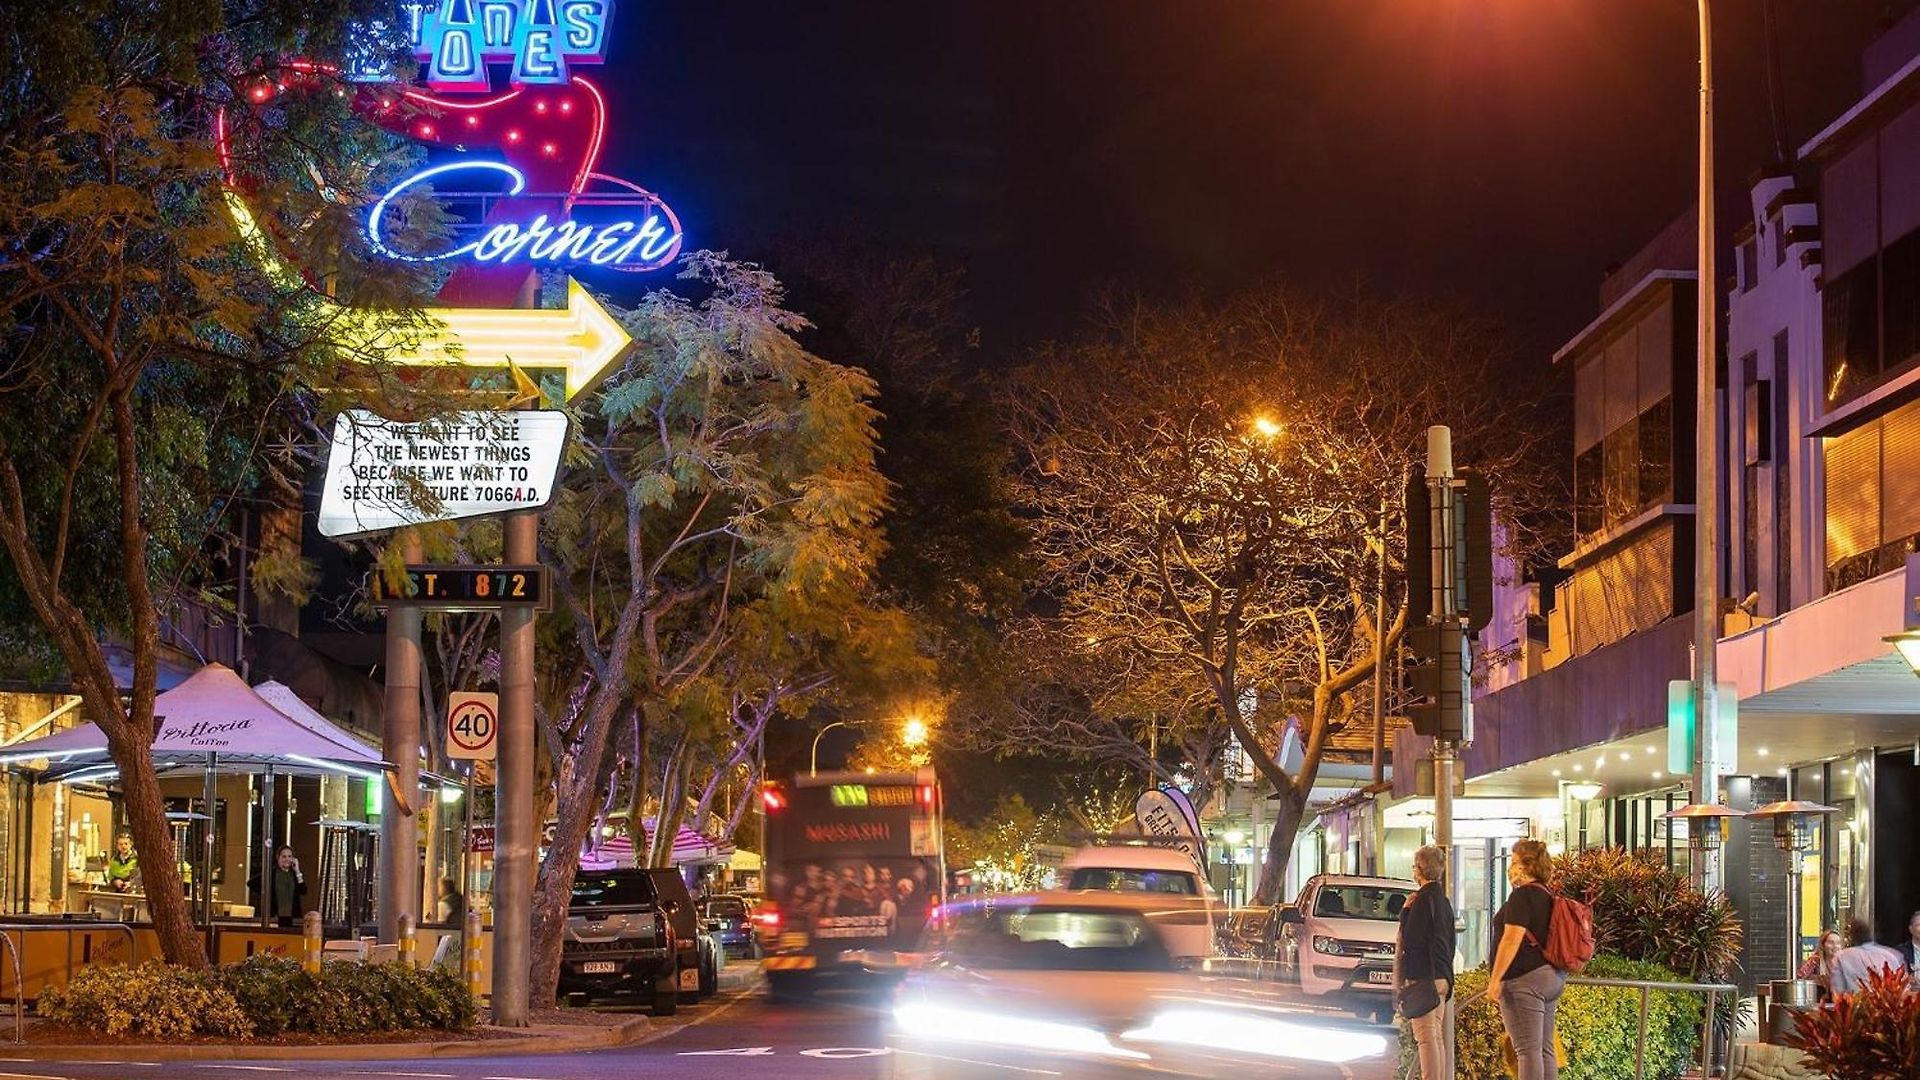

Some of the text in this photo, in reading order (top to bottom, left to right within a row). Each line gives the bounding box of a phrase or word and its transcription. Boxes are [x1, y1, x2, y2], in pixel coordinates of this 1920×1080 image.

[468, 426, 486, 441] TO
[493, 426, 519, 441] SEE
[375, 446, 530, 461] THE NEWEST THINGS
[432, 466, 454, 481] WE
[460, 466, 502, 481] WANT
[509, 467, 528, 481] TO
[343, 486, 370, 500] SEE
[411, 486, 469, 501] TURE
[455, 713, 489, 737] 40
